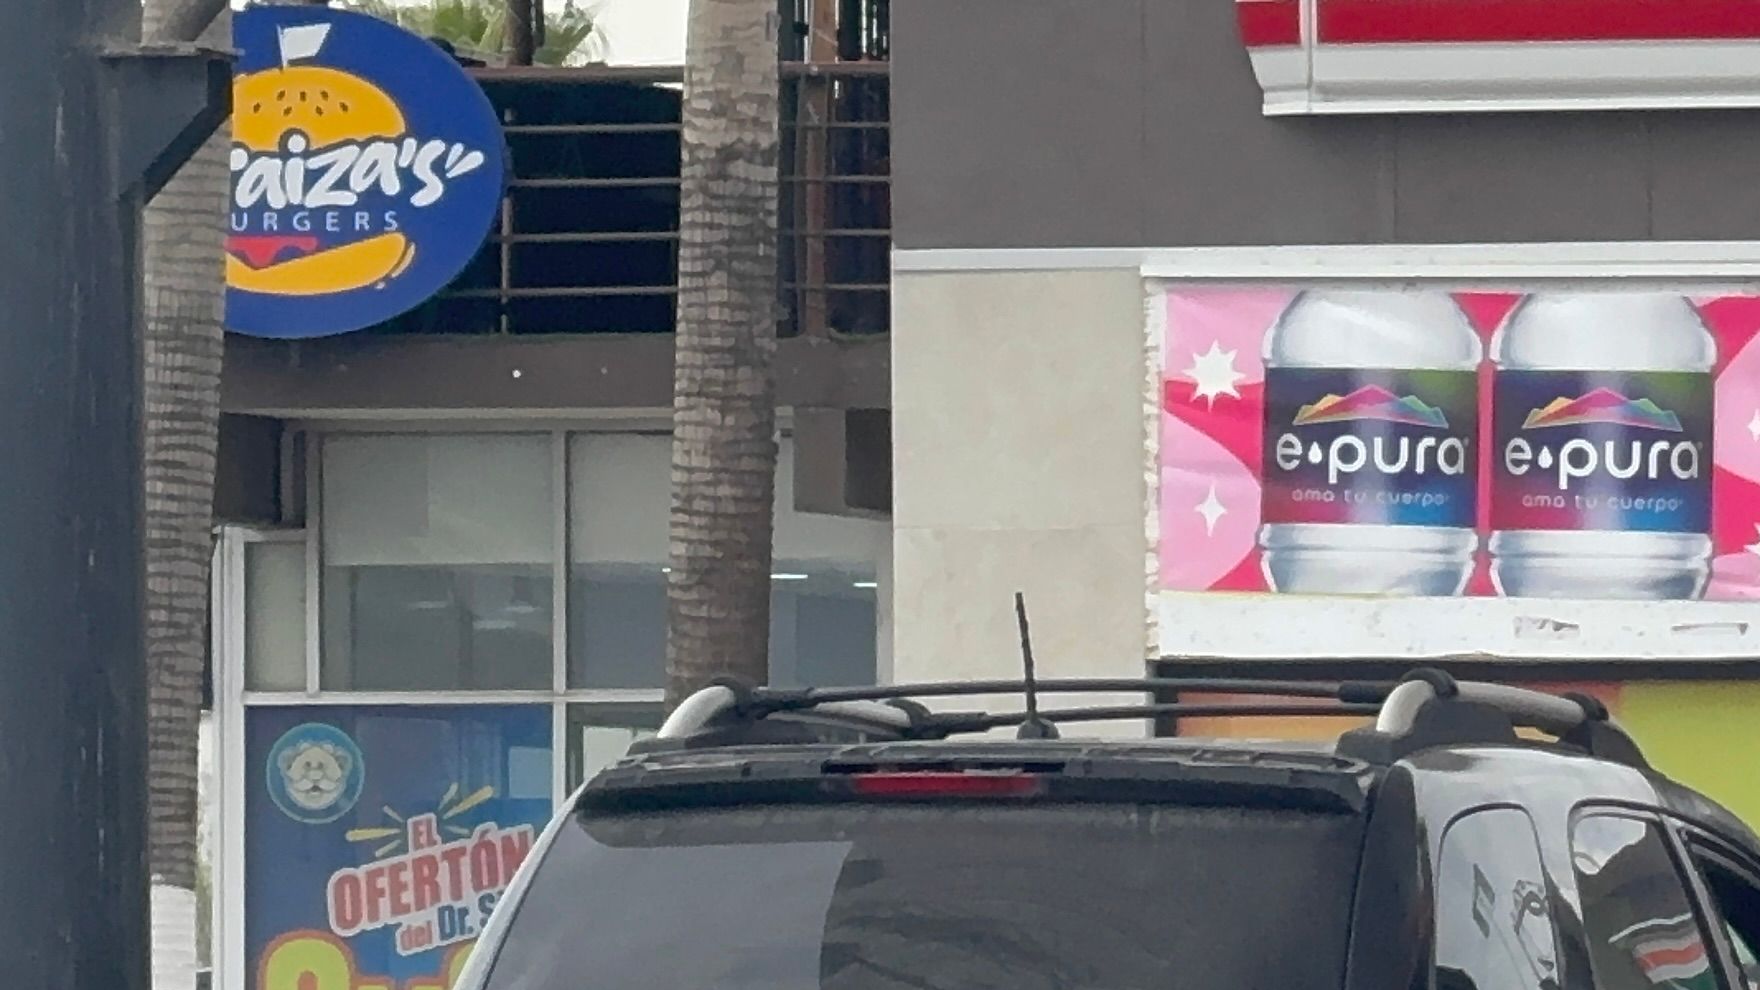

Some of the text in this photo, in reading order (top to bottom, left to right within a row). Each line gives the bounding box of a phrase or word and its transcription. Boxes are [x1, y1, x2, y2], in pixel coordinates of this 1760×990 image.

[1292, 488, 1446, 507] ama tu cuerpo
[1522, 493, 1679, 513] ama tu cuerpo
[412, 819, 438, 850] EL
[333, 827, 529, 931] OFERTÓN
[399, 890, 504, 951] del Dr. S
